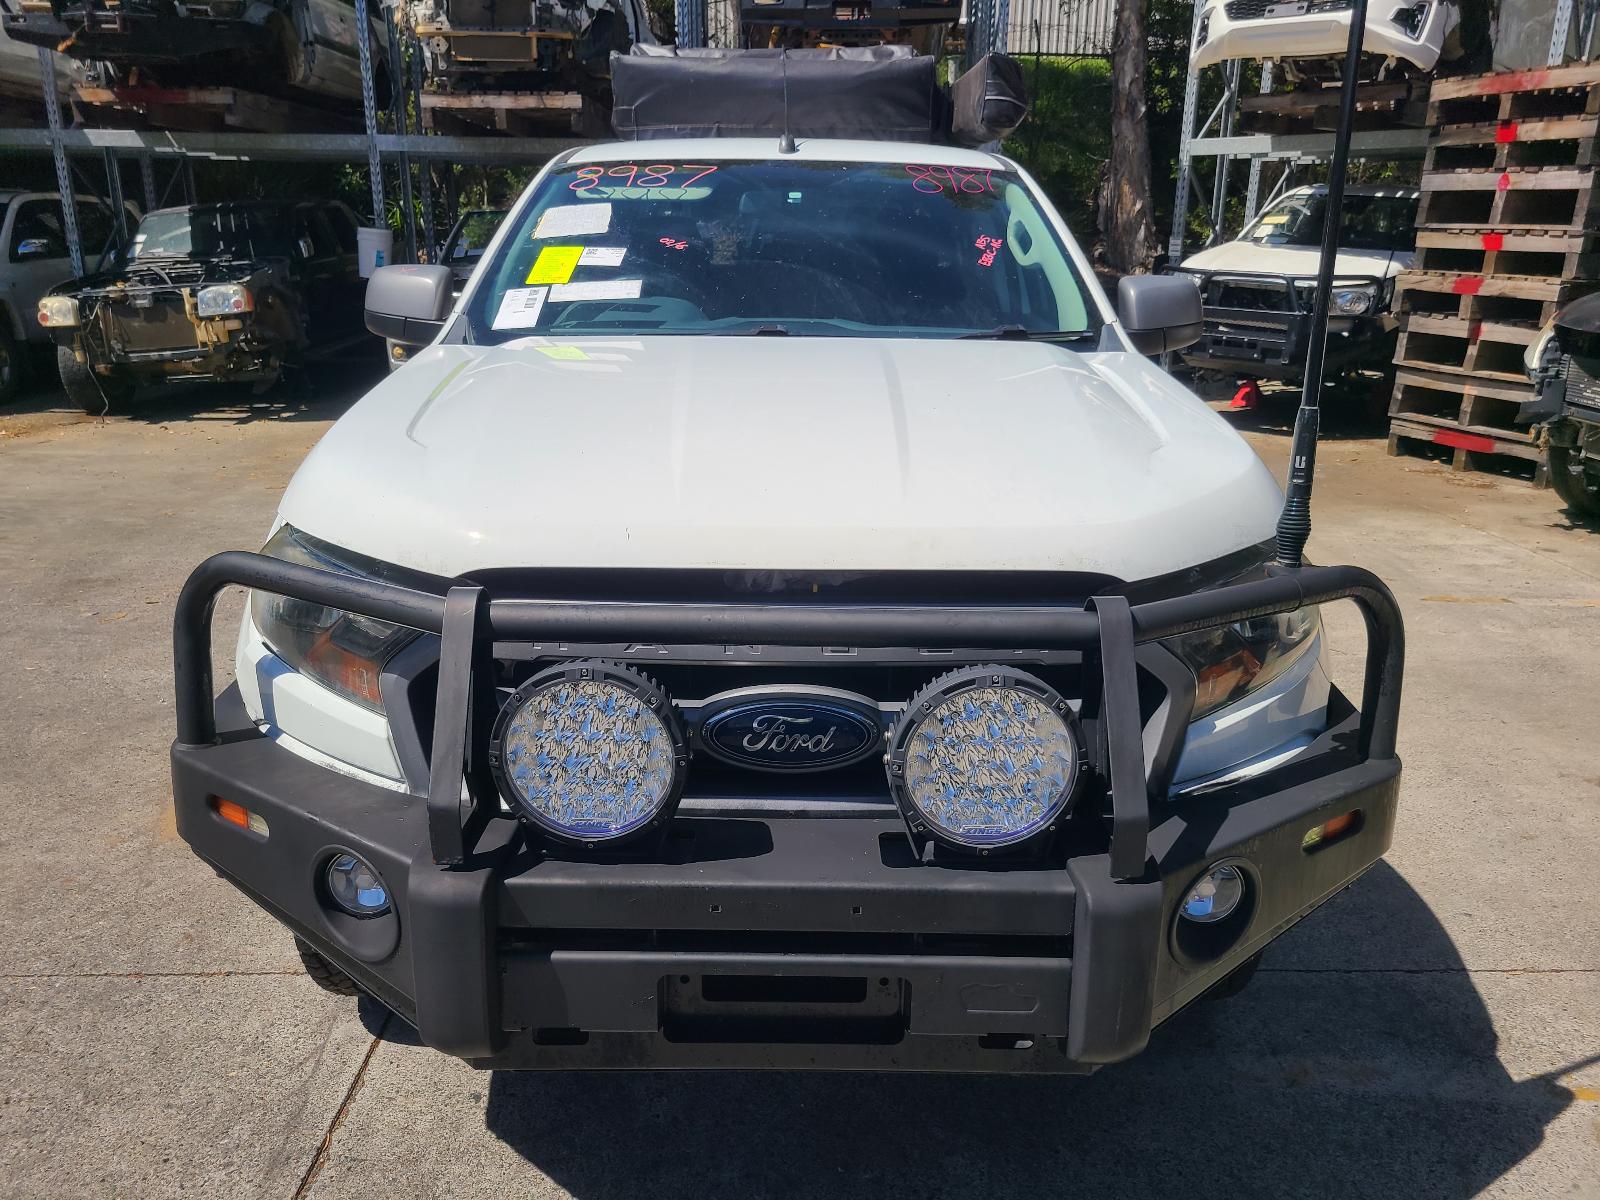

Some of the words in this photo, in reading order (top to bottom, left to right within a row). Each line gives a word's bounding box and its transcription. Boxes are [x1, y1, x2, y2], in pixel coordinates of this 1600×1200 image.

[568, 164, 718, 191] 8987
[904, 165, 996, 194] 8987
[742, 714, 838, 753] Ford
